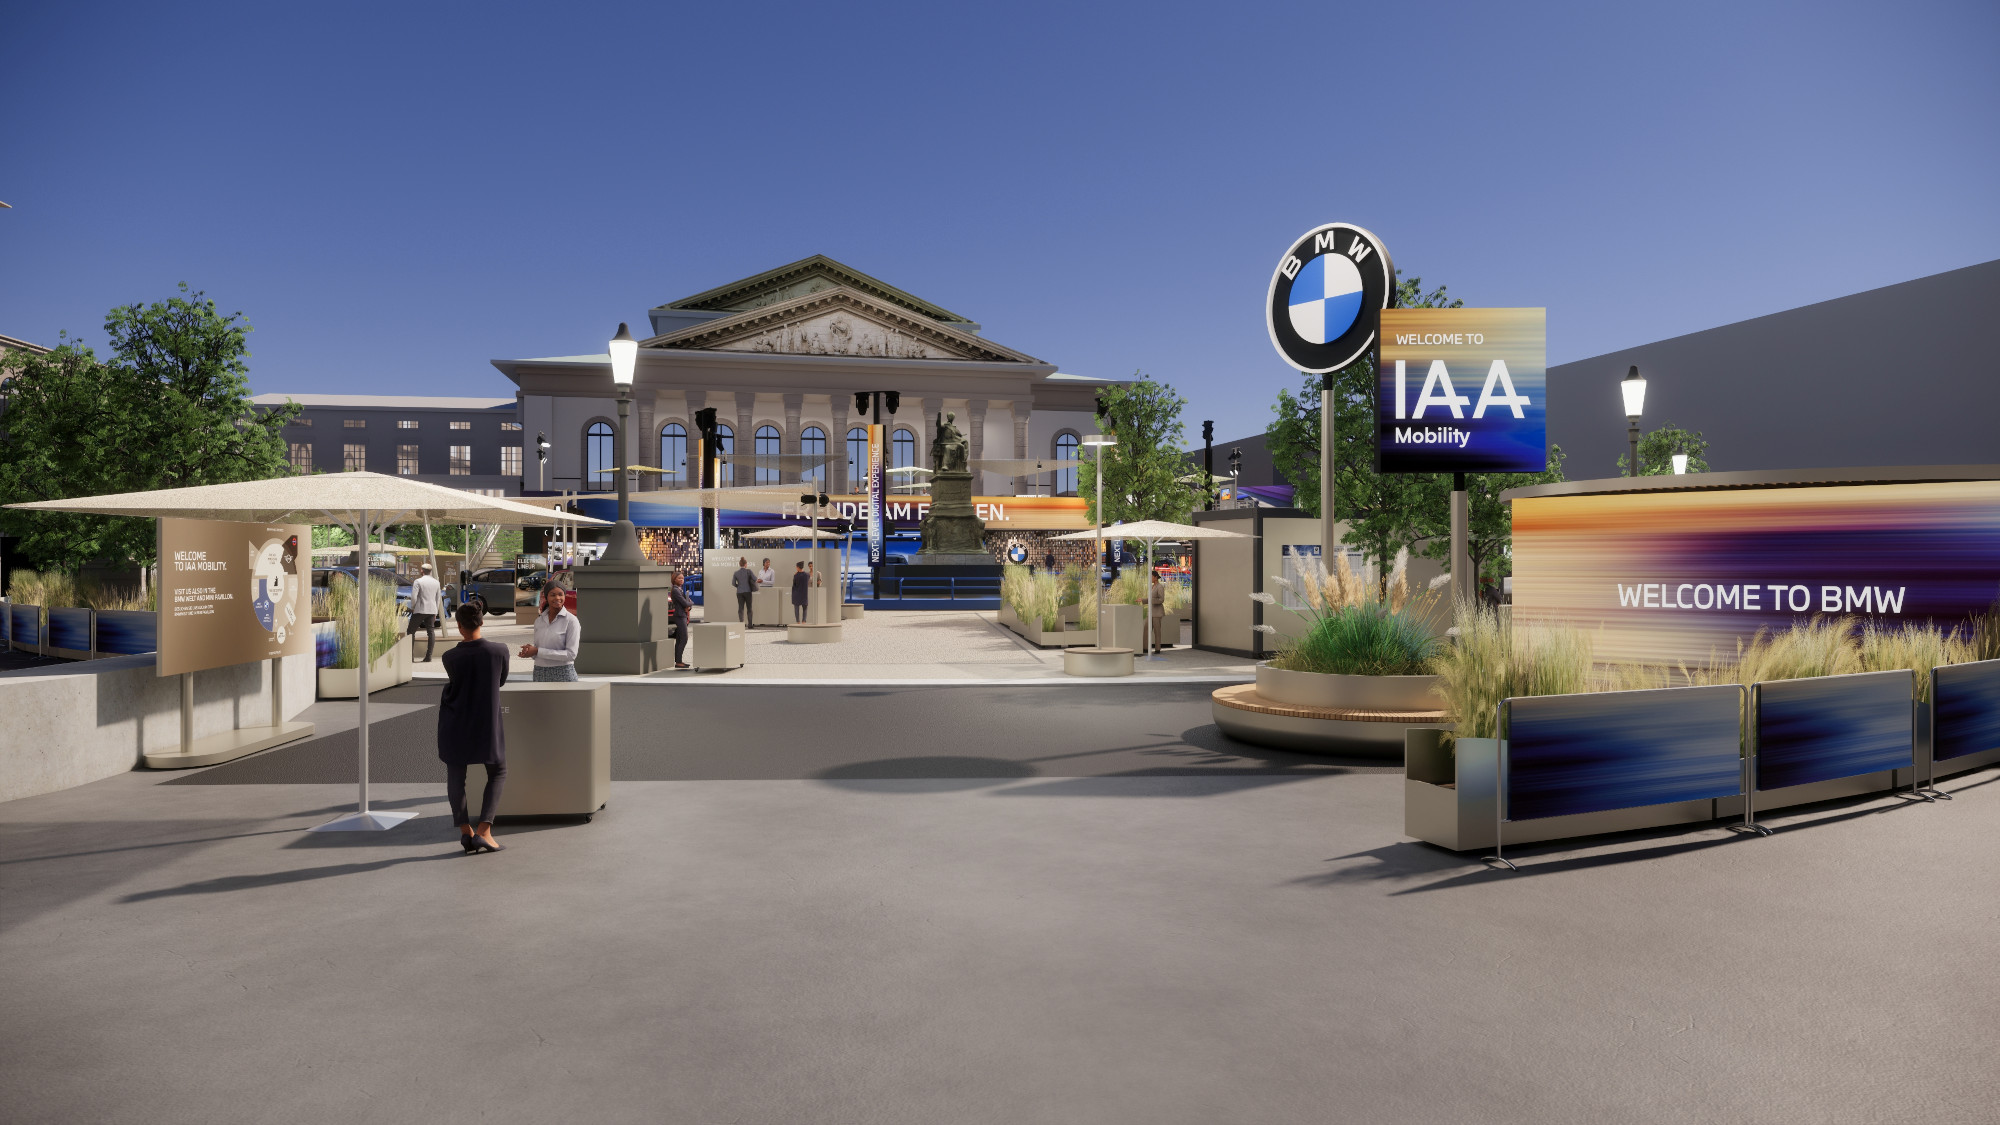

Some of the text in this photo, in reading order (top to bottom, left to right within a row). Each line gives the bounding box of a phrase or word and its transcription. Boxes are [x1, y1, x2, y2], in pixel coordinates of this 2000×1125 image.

[1281, 230, 1372, 280] BMW
[1396, 333, 1484, 345] WELCOME TO
[1395, 359, 1531, 419] IAA
[1395, 426, 1471, 448] Mobility
[871, 443, 880, 563] NEXT-LEVEL DIGITAL EXPERIENCE
[174, 551, 207, 561] WELCOME
[174, 561, 184, 571] TO
[185, 561, 196, 571] IAA
[1617, 583, 1906, 614] WELCOME TO BMW
